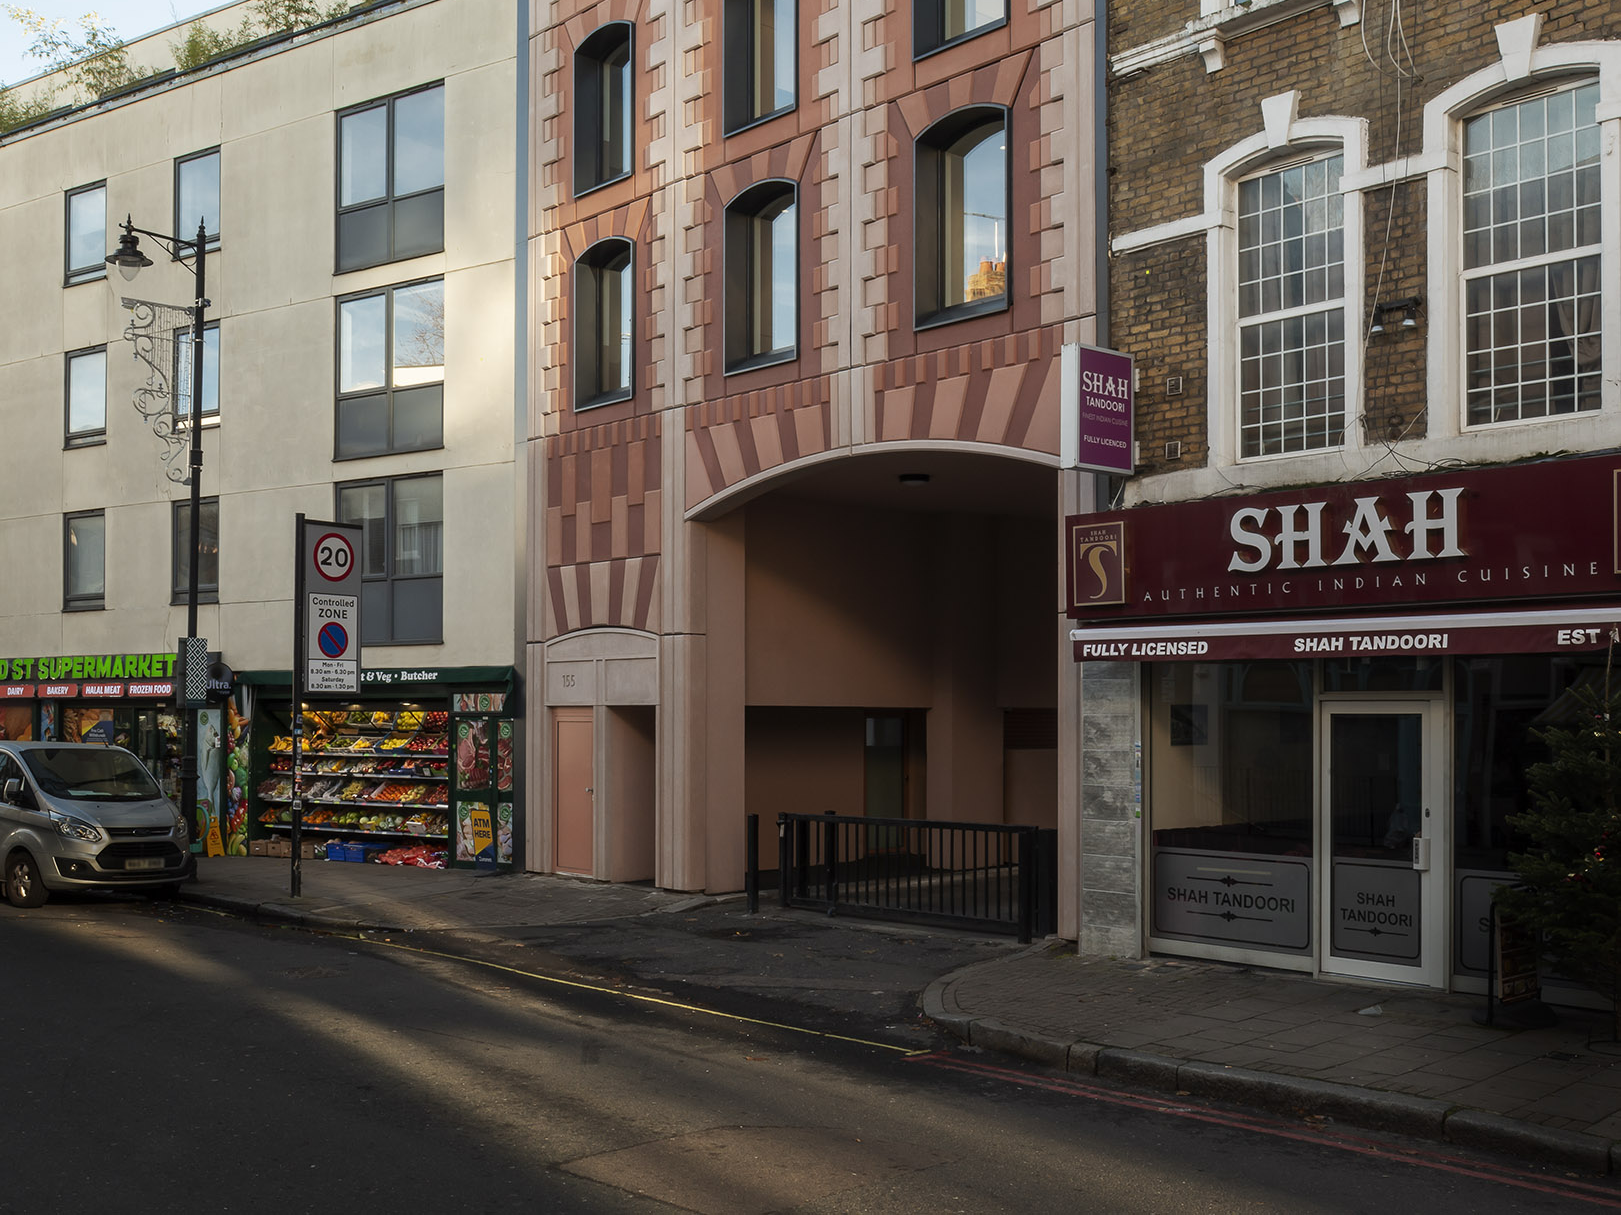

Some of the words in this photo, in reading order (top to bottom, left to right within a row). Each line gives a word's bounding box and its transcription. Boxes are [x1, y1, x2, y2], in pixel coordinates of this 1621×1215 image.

[1082, 371, 1128, 399] SHAH
[1086, 396, 1125, 412] TANDOORI
[1083, 434, 1100, 444] FULLY
[1228, 487, 1467, 572] SHAH
[1080, 534, 1117, 542] TANDOORI
[320, 546, 348, 567] 20
[1143, 582, 1291, 601] AUTHENTIC
[1318, 573, 1426, 591] INDIAN
[1457, 562, 1598, 583] CUISINE
[312, 597, 354, 607] Controlled
[318, 608, 348, 619] ZONE
[1083, 643, 1129, 657] FULLY
[1131, 641, 1208, 656] LICENSED
[1293, 637, 1344, 652] SHAH
[1349, 633, 1449, 651] TANDOORI
[1557, 628, 1600, 645] EST
[12, 658, 34, 680] ST
[38, 653, 177, 680] SUPERMARKET
[367, 671, 375, 681] &
[376, 671, 392, 683] Veg
[400, 671, 438, 681] Butcher
[562, 675, 575, 687] 155
[7, 687, 24, 695] DAIRY
[46, 686, 69, 695] BAKERY
[85, 685, 103, 694] HALAL
[103, 685, 121, 694] MEAT
[129, 685, 153, 694] FROZEN
[153, 684, 171, 694] FOOD
[473, 818, 490, 828] ATM
[474, 830, 491, 839] HERE
[1167, 887, 1208, 904] SHAH
[1213, 891, 1295, 914] TANDOORI
[1356, 892, 1395, 907] SHAH
[1340, 908, 1413, 927] TANDOORI
